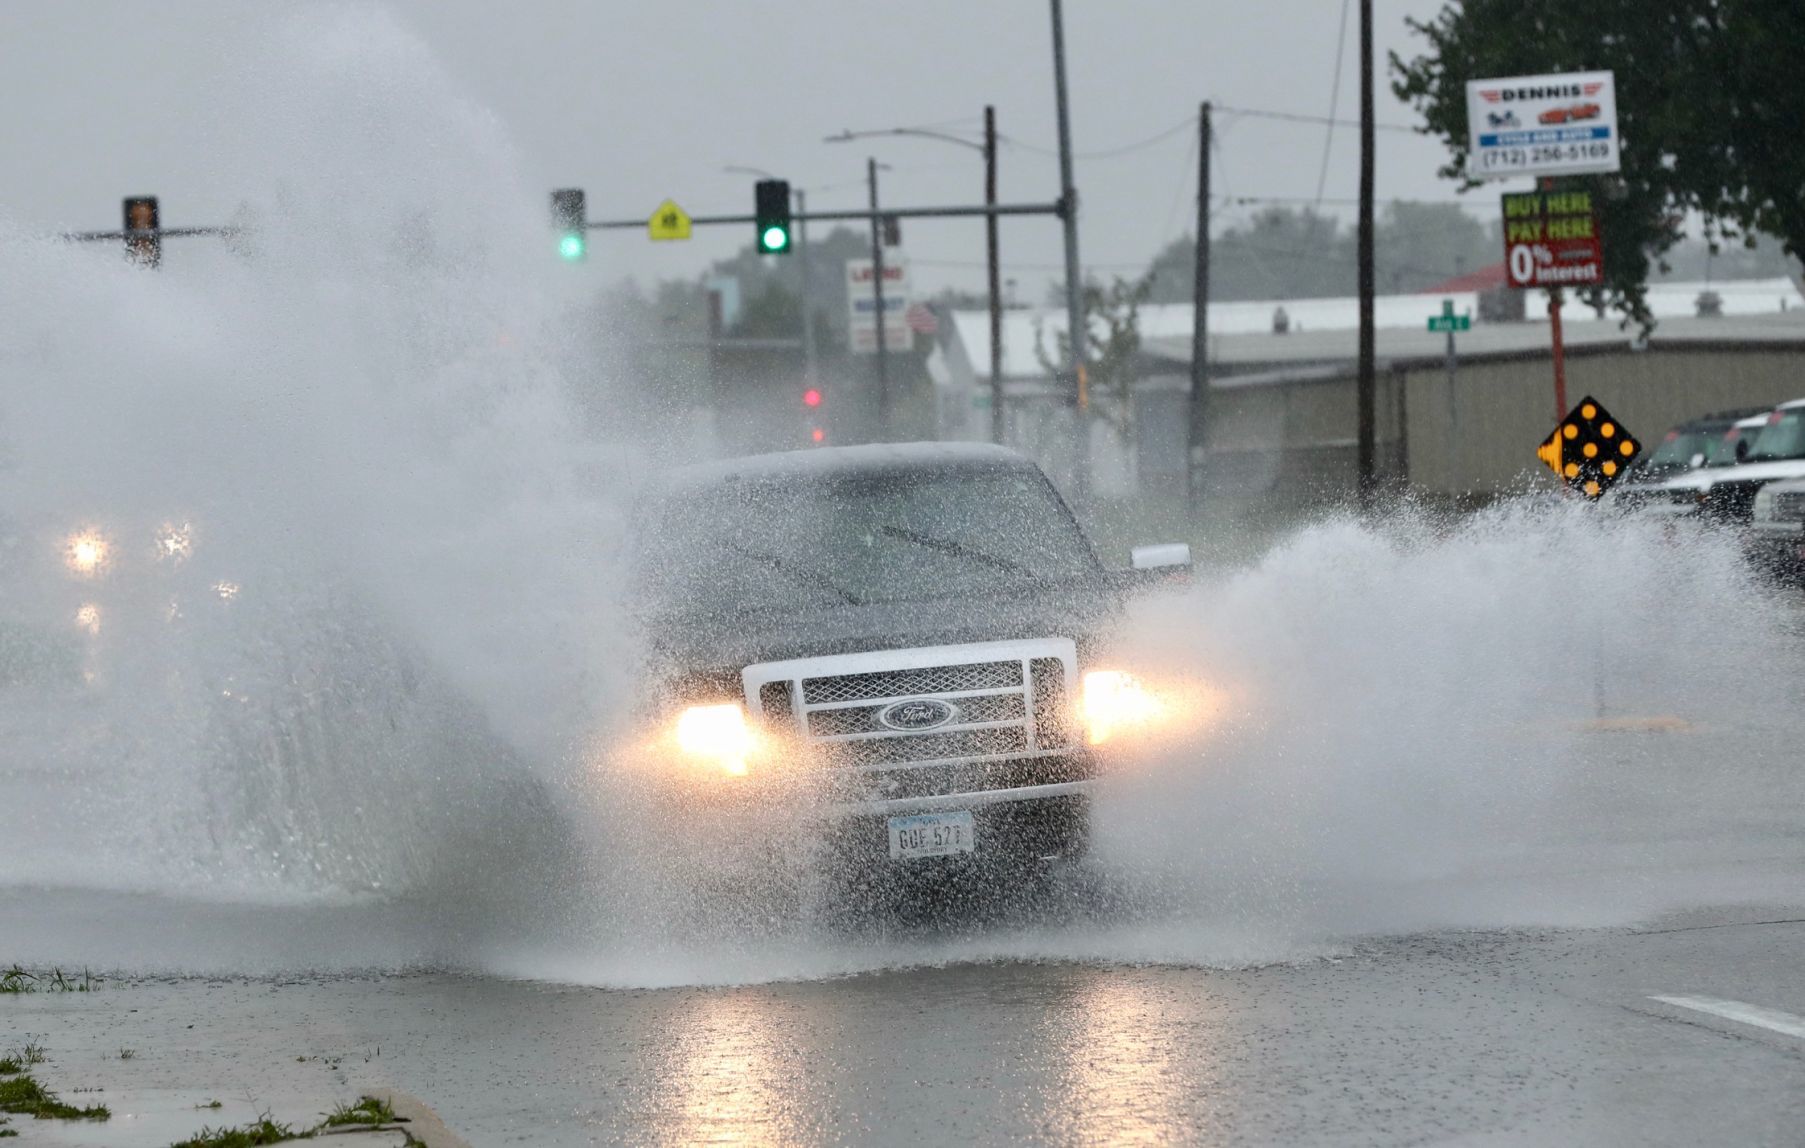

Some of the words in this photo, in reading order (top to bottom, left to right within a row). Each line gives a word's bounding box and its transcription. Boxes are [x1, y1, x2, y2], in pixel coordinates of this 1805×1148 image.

[1502, 84, 1581, 101] DENNIS
[1484, 150, 1526, 168] (712)
[1505, 194, 1541, 217] BUY
[1547, 192, 1591, 214] HERE
[1508, 221, 1541, 243] PAY
[1548, 217, 1592, 239] HERE
[1510, 244, 1552, 283] 0%
[904, 705, 934, 721] Ford
